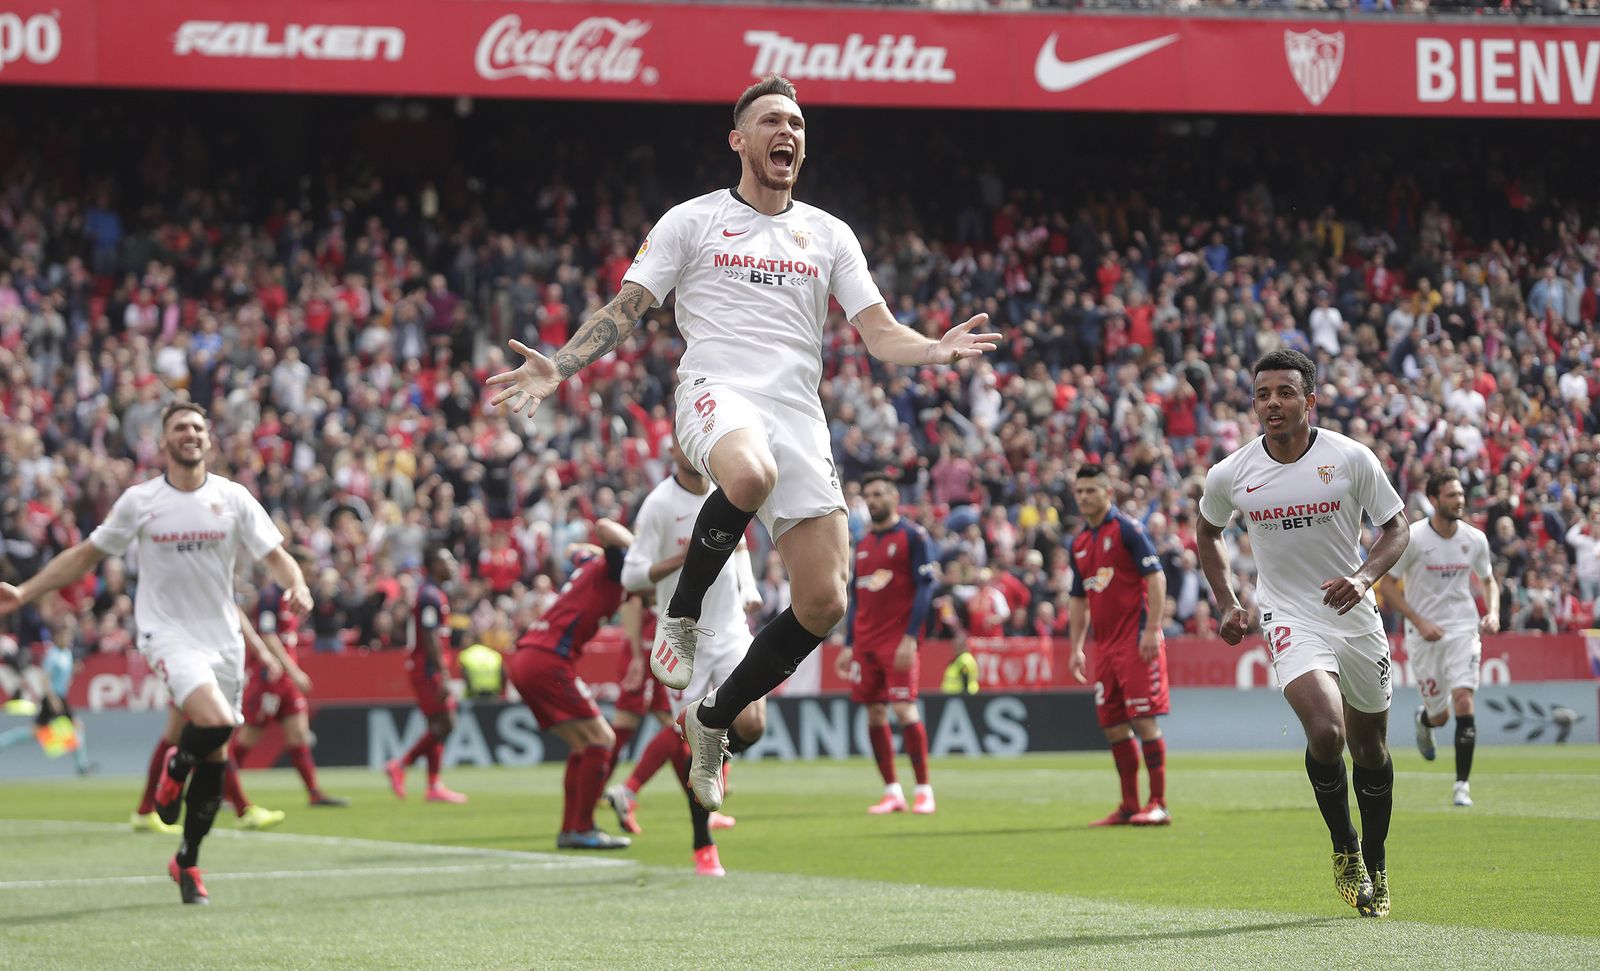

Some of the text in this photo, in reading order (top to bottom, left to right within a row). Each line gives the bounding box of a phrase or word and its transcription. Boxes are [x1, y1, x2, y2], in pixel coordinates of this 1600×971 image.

[174, 20, 405, 61] FALKEN
[1416, 37, 1600, 104] BIENV
[714, 253, 819, 278] MARATHON
[750, 270, 786, 286] BET
[694, 392, 716, 418] 5
[1249, 500, 1341, 522] MARATHON
[1282, 516, 1313, 530] BET
